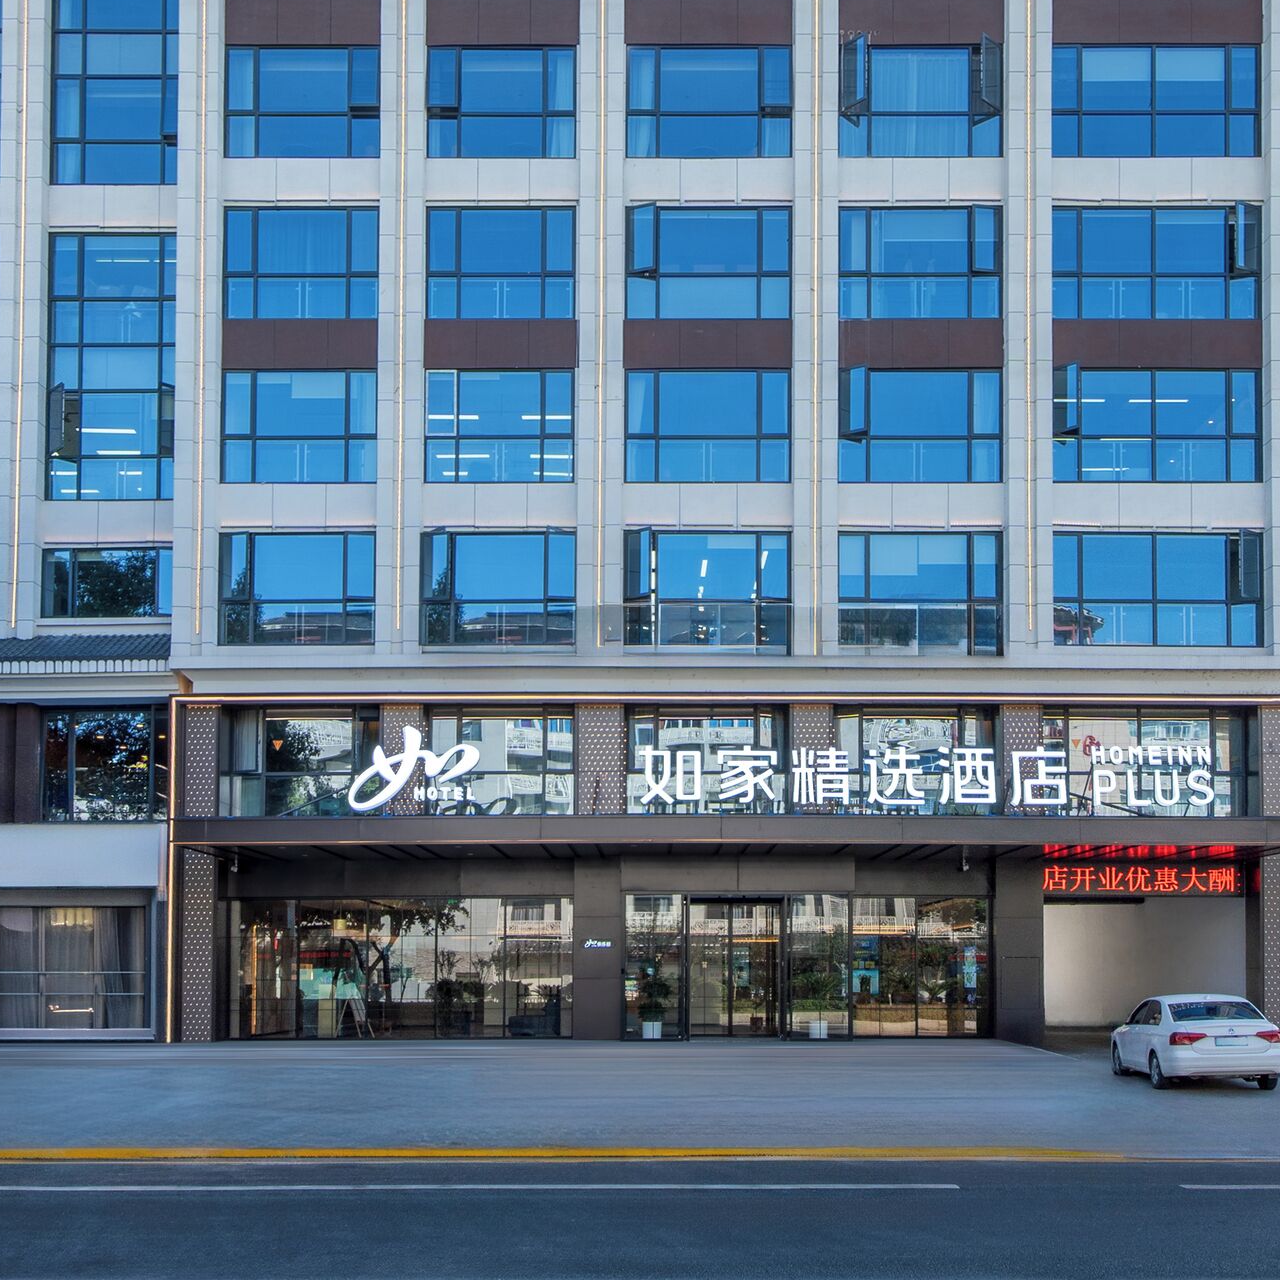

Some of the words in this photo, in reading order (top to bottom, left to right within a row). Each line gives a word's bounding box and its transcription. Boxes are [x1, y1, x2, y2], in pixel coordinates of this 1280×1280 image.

[1090, 745, 1212, 766] HOMEINN
[638, 745, 1068, 806] 如家精选酒店
[1092, 769, 1215, 807] PLUS
[413, 786, 476, 801] HOTEL
[1042, 865, 1241, 893] 店开业优惠大酬
